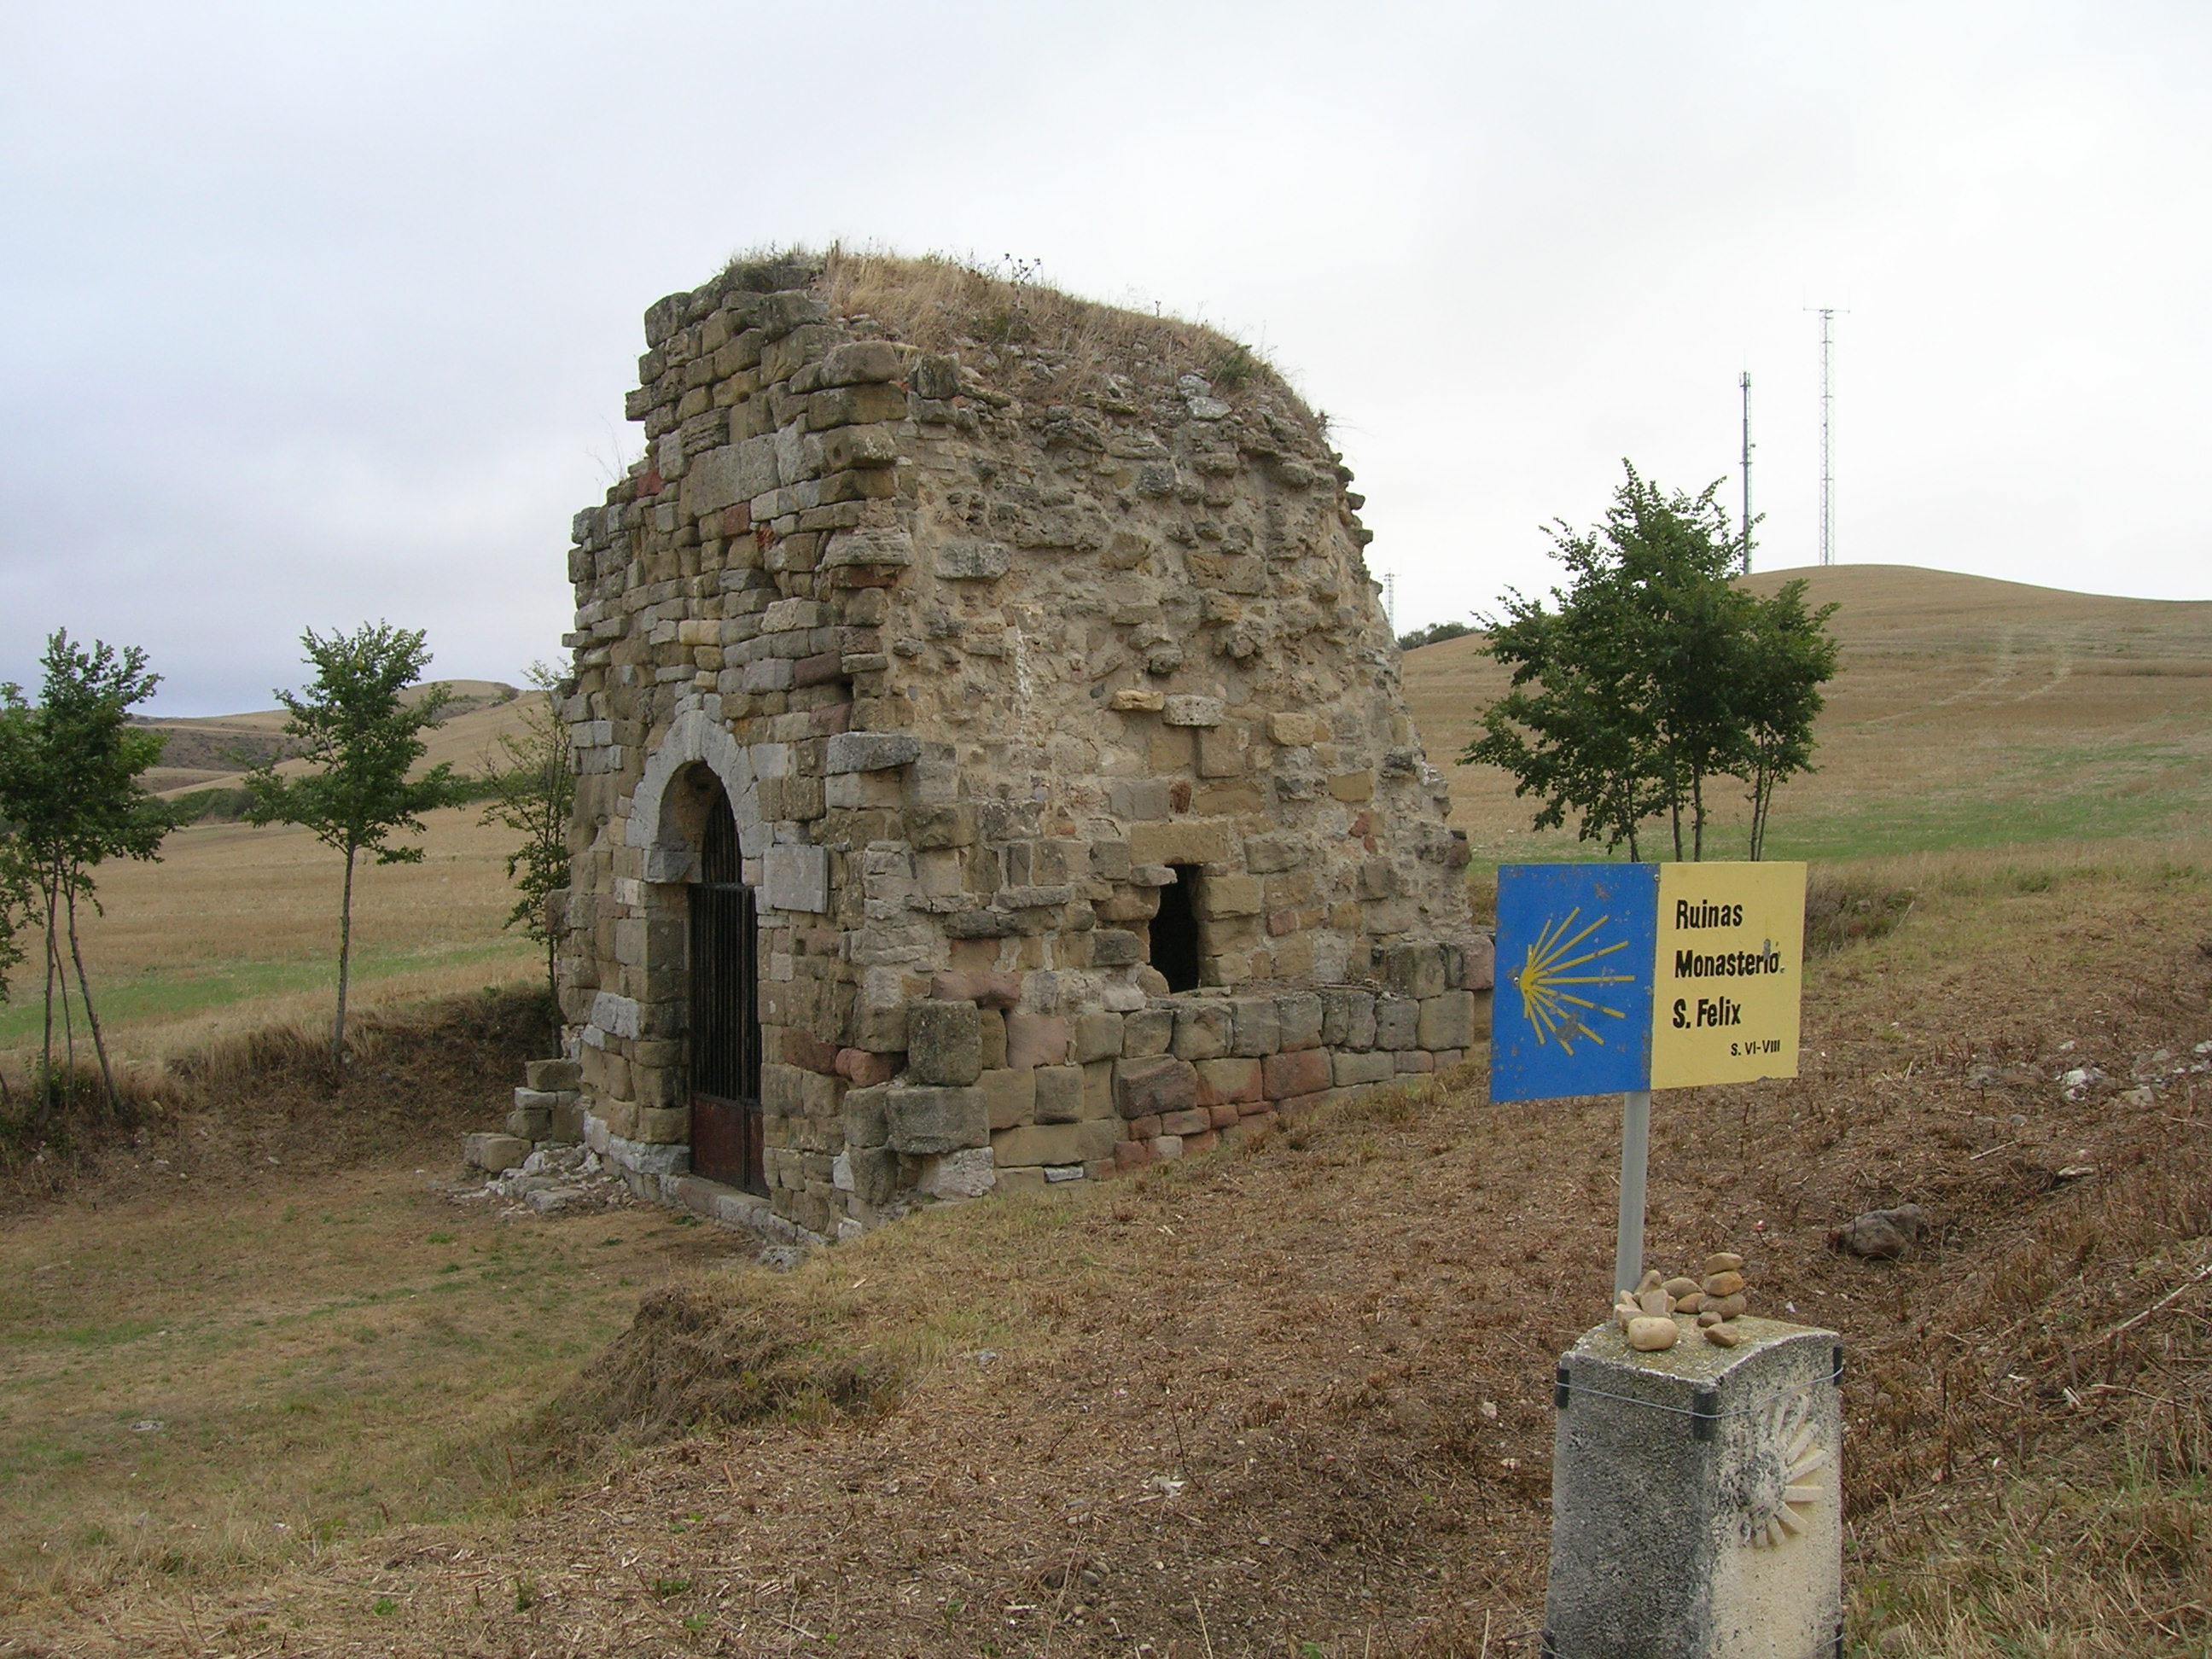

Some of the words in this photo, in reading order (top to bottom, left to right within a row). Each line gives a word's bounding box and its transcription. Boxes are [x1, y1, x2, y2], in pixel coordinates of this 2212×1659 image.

[1675, 899, 1743, 929] Ruinas
[1674, 950, 1779, 978] Monasterio
[1673, 998, 1691, 1029] S.
[1697, 996, 1741, 1027] Felix
[1744, 1039, 1780, 1055] VI-VIII
